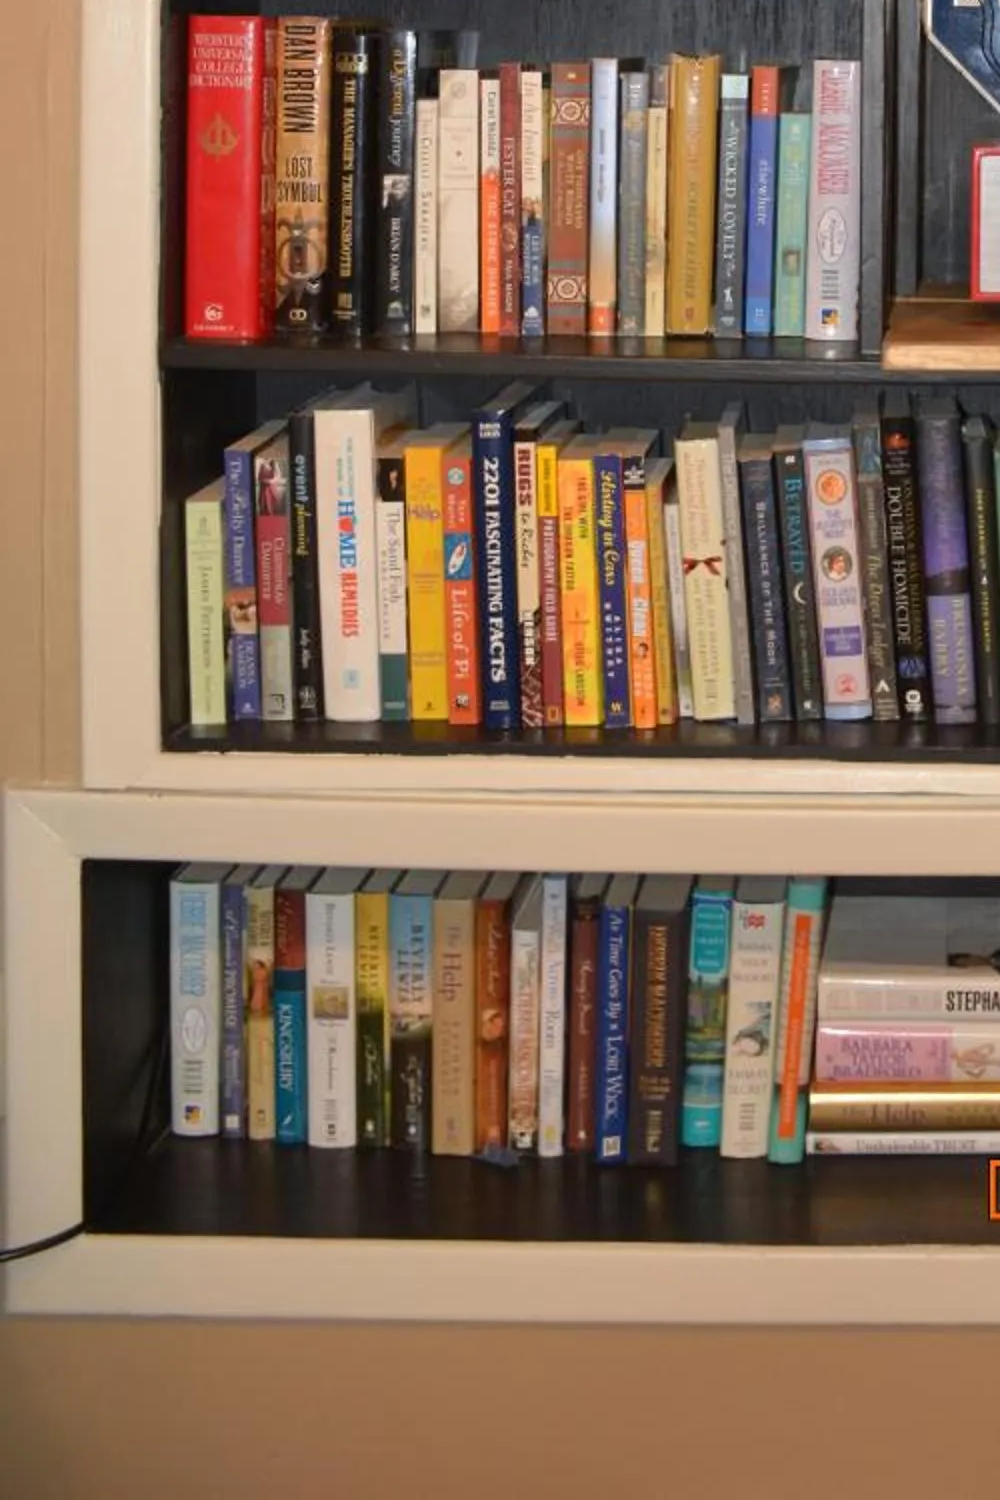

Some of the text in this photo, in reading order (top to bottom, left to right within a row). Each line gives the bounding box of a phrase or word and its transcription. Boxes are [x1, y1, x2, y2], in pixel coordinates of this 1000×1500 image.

[283, 24, 317, 133] DAN BROWN
[343, 79, 356, 102] THE
[277, 181, 322, 204] SYMBOL
[285, 155, 313, 178] LOST
[756, 159, 770, 226] elsewhere
[502, 188, 515, 217] CAT
[722, 135, 738, 262] WICKED LOVELY
[390, 217, 402, 249] BRIAN
[294, 454, 311, 556] event planning
[517, 447, 532, 506] RUGS
[521, 527, 537, 567] Riches
[603, 531, 617, 547] in
[782, 478, 806, 573] BETRAYED
[387, 511, 403, 603] The Sand Fish
[483, 456, 507, 682] 2201 FASCINATING FACTS
[603, 550, 621, 585] Cars
[756, 501, 777, 665] BRILLIANCE OF THE MOON
[866, 555, 880, 579] The
[887, 486, 911, 644] DOUBLE HOMICIDE
[340, 571, 359, 636] REMEDIES
[451, 588, 471, 679] Life of Pi
[868, 622, 889, 667] Lodger
[437, 952, 463, 1002] Help
[609, 935, 624, 964] Time
[608, 968, 622, 997] Goes
[278, 1003, 294, 1091] KINGSBURY
[604, 1036, 623, 1118] LORI WICK
